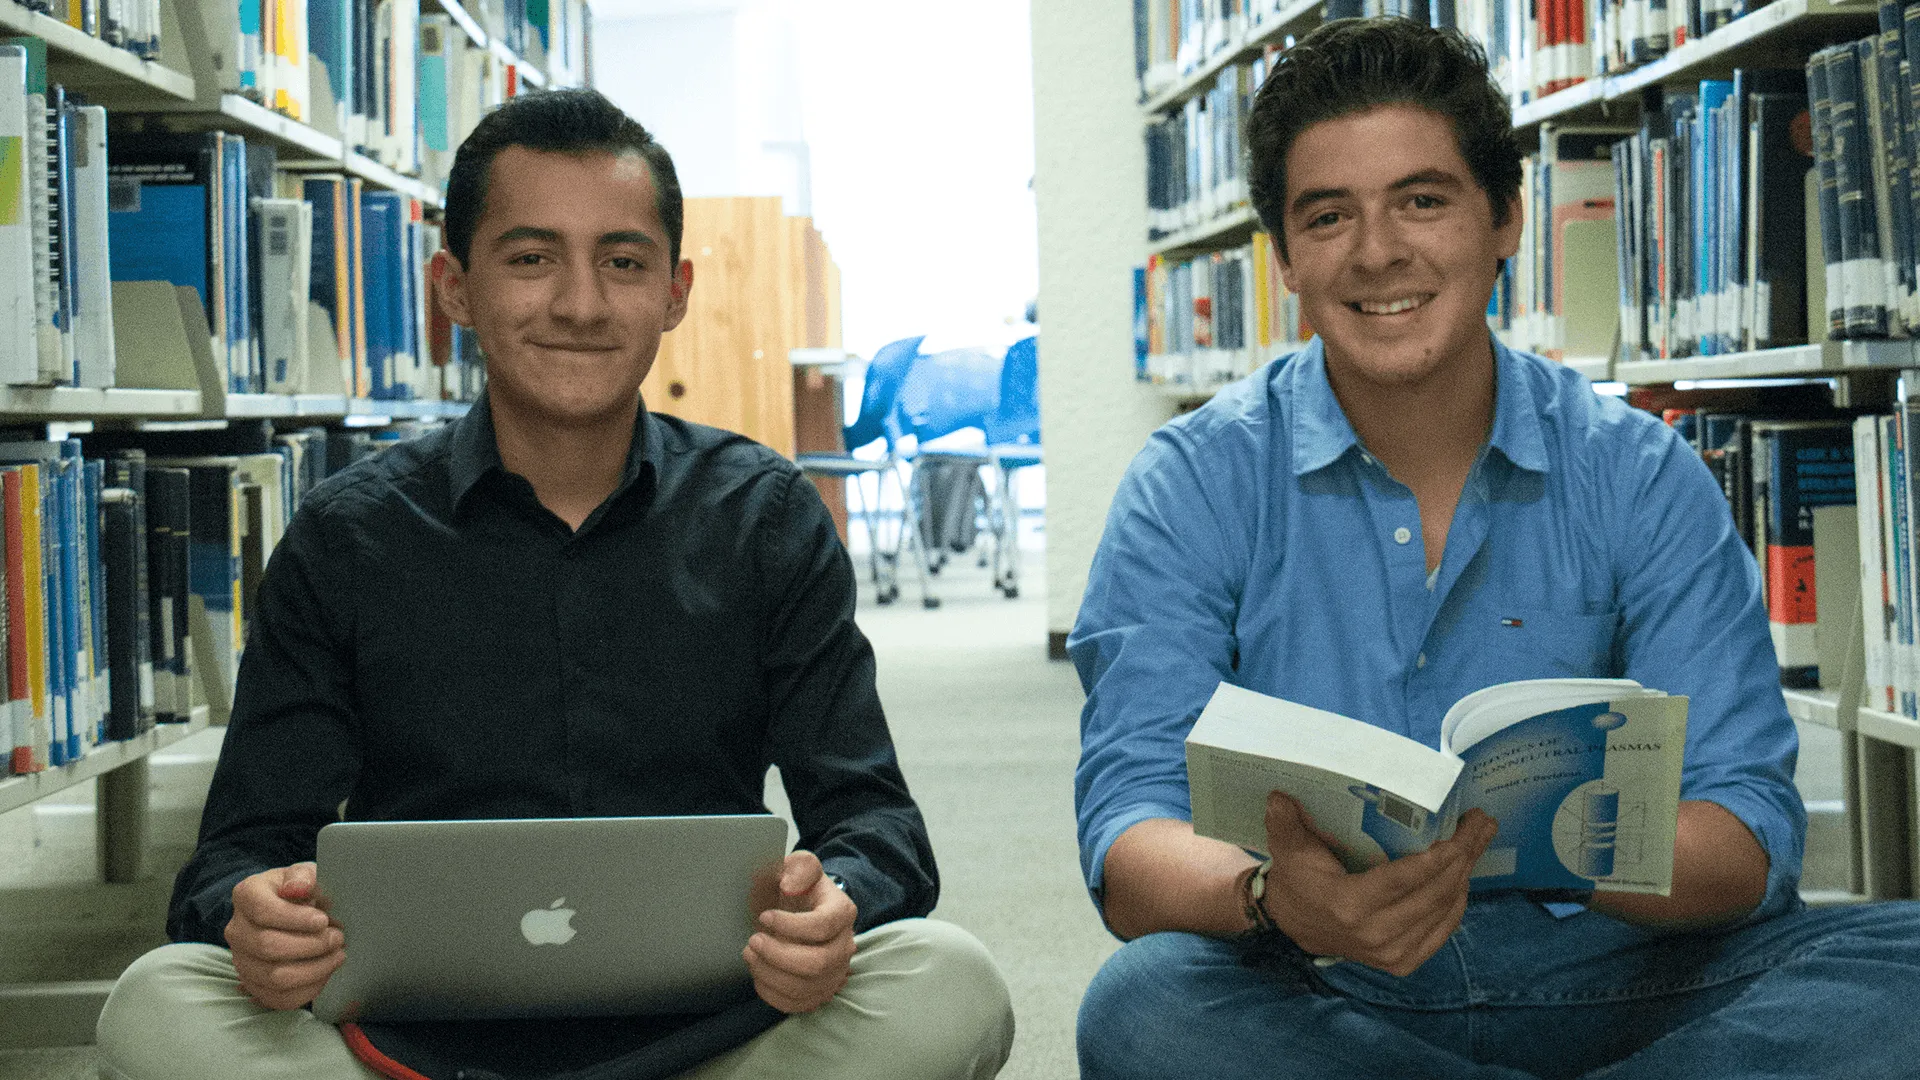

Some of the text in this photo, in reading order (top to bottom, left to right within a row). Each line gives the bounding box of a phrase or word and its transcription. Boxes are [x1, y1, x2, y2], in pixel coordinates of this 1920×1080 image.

[1472, 737, 1562, 772] PHYSICS OF
[1472, 742, 1662, 782] NONNEUTRAL PLASMAS
